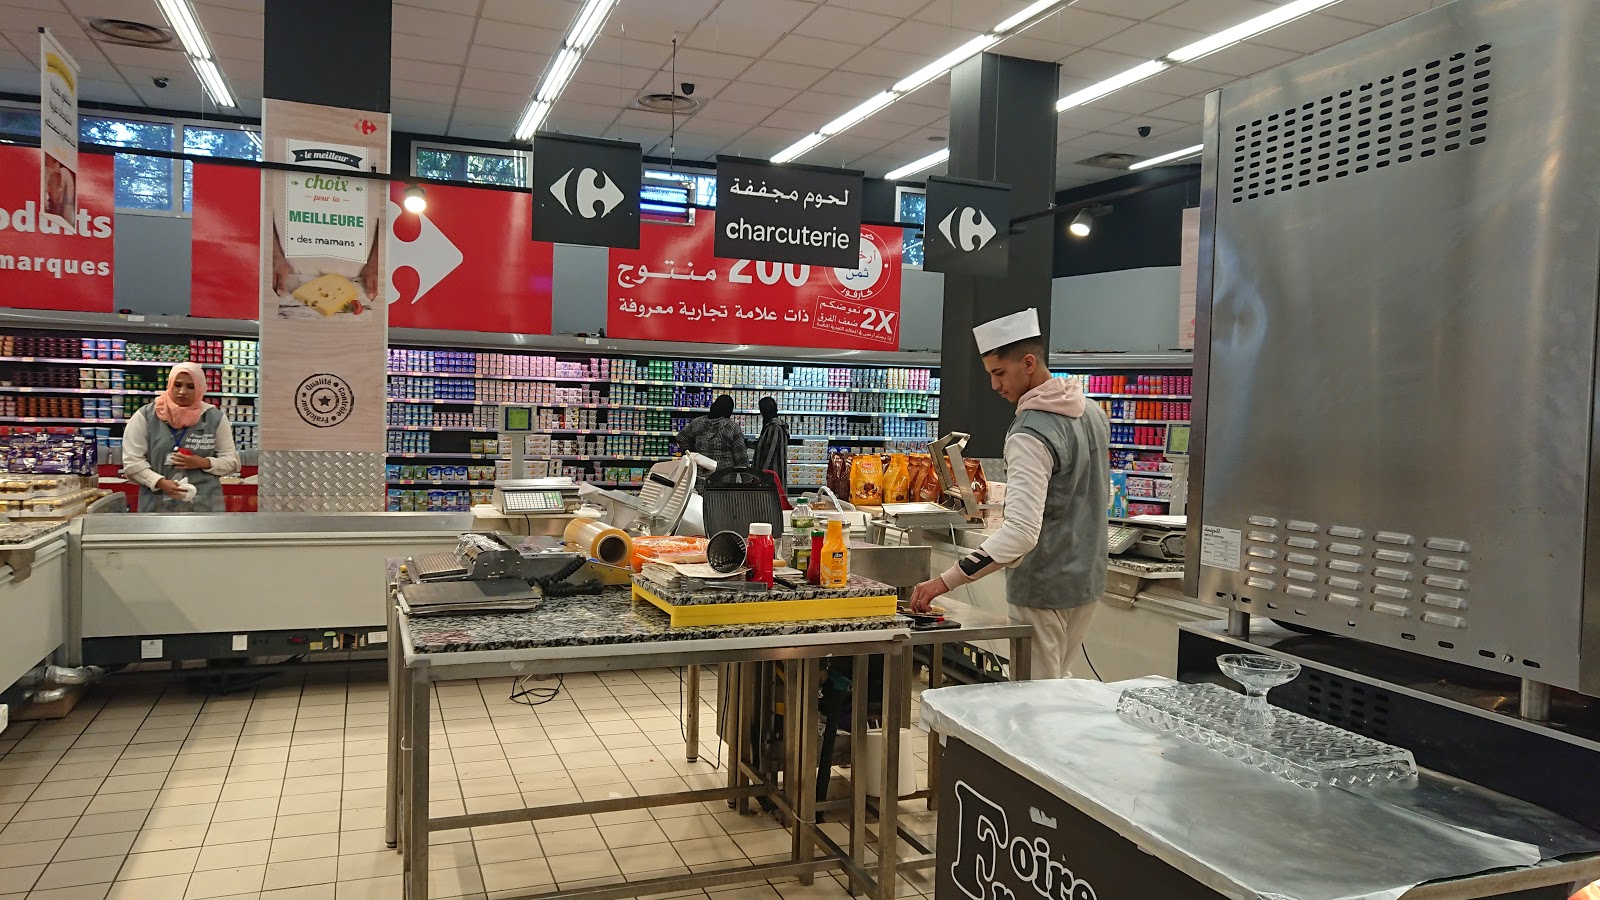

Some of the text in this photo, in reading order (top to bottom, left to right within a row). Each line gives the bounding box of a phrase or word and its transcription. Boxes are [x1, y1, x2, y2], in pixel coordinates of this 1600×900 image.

[304, 151, 348, 163] le meilleur
[304, 175, 349, 192] choix
[729, 178, 849, 210] لحوم مجففة
[0, 200, 112, 239] oduts
[289, 210, 364, 228] MEILLEURE
[296, 235, 355, 247] des mamans
[725, 217, 850, 249] charcuterie
[0, 254, 110, 279] marques
[859, 250, 876, 264] أرخ
[841, 288, 873, 299] كارفور
[619, 298, 809, 322] ذات علامة تجارية معروفة
[860, 308, 895, 334] 2X
[305, 378, 332, 391] Qualité
[336, 387, 349, 417] Contrôle
